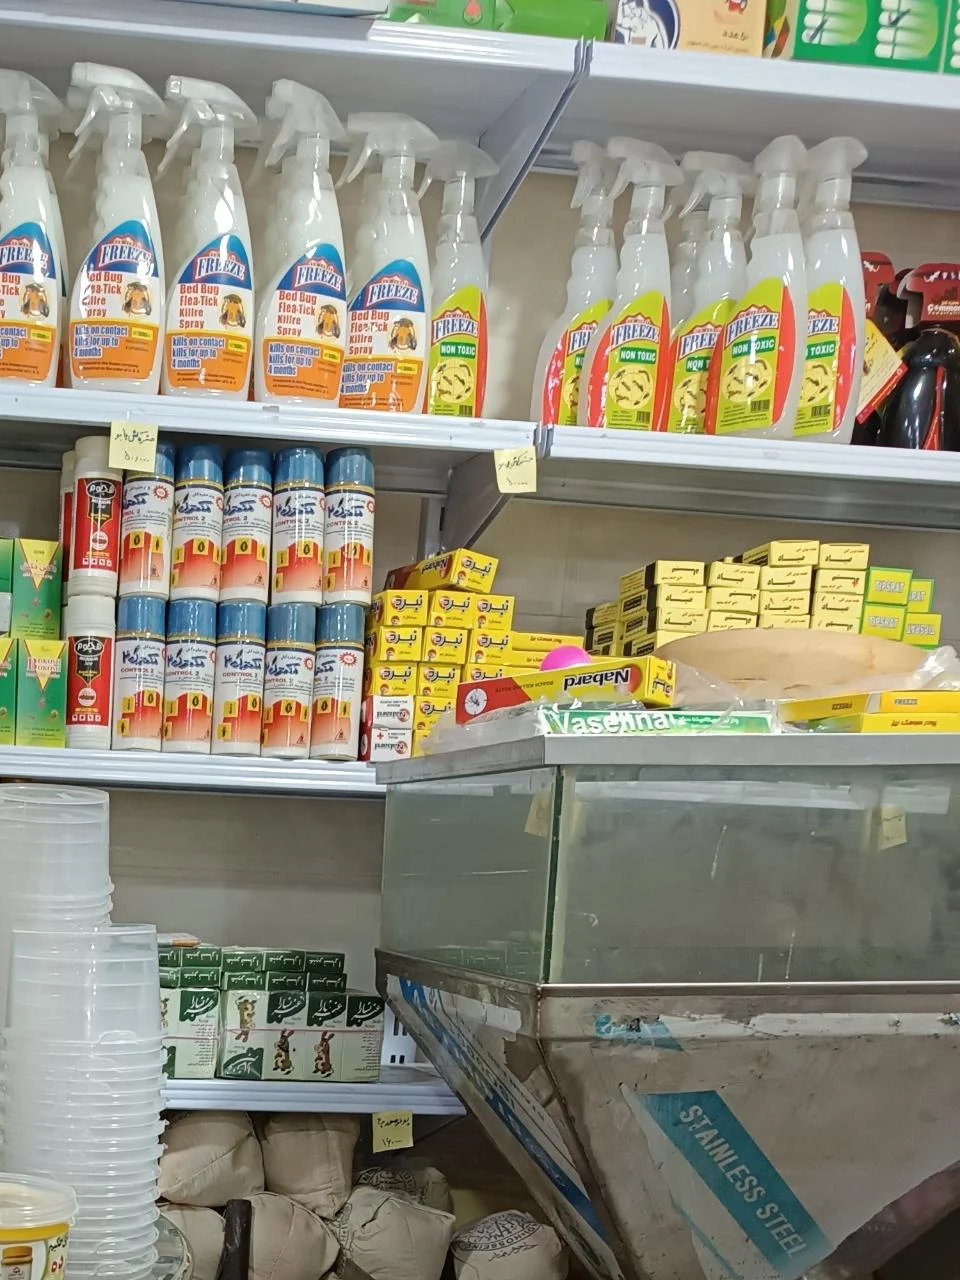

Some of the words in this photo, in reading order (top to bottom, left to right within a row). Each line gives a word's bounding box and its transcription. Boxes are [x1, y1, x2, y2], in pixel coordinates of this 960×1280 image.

[0, 246, 49, 269] FREEE
[297, 266, 343, 290] FREEZE
[180, 285, 198, 295] Bed
[201, 285, 219, 298] Bug
[279, 291, 297, 300] Bed
[300, 292, 318, 305] Bug
[371, 283, 418, 306] FREEZE
[435, 318, 478, 338] FREEZE
[726, 312, 778, 341] FREEZE
[612, 323, 659, 347] FREEZE
[441, 345, 456, 354] NON
[749, 340, 774, 353] OXIC
[811, 342, 835, 354] TOXIC
[621, 350, 635, 360] NON
[637, 351, 655, 361] TOXIC
[464, 558, 493, 577] نبرد
[395, 595, 423, 611] نبرد
[441, 597, 470, 613] نبرد
[481, 600, 509, 615] نبرد
[390, 630, 417, 645] نبرد
[435, 633, 463, 649] نبرد
[481, 635, 508, 650] نبرد
[384, 667, 412, 682] نبرد
[564, 667, 631, 691] Nabard
[679, 1105, 766, 1203] STAINLESS
